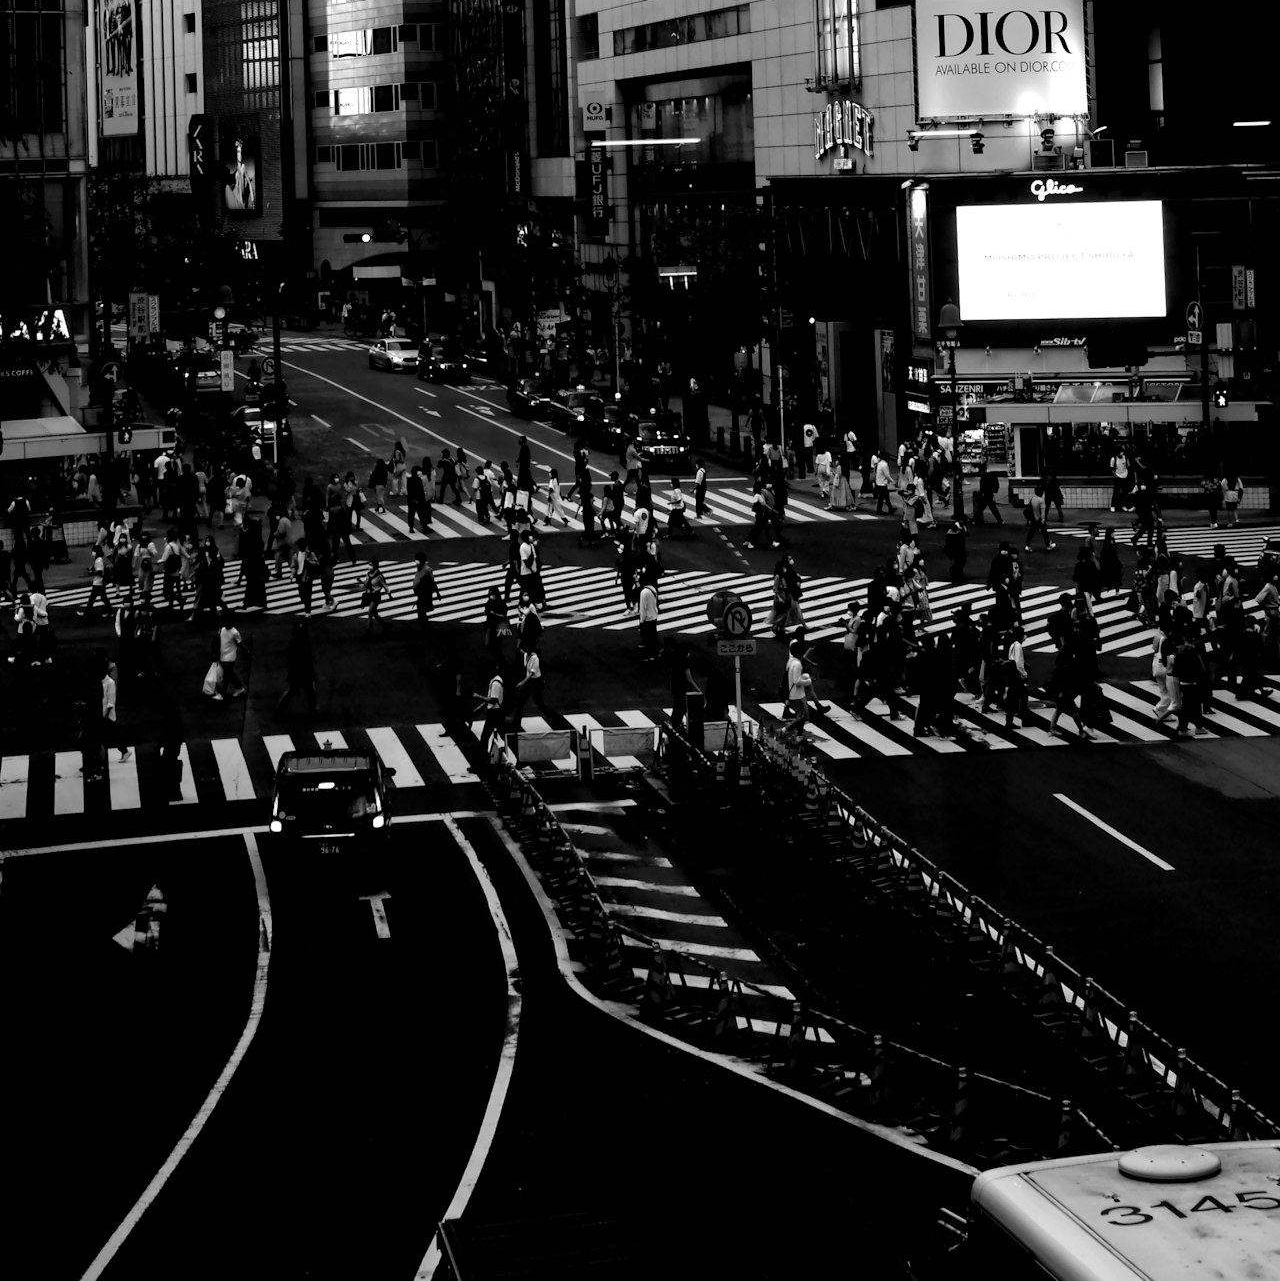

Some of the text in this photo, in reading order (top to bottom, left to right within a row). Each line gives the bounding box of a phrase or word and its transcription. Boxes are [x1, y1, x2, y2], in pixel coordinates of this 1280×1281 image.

[933, 9, 1073, 58] DIOR
[935, 59, 1075, 76] AVAILABLE ON DIOR.CO
[814, 99, 874, 160] MAGNET
[1030, 179, 1084, 202] Glico
[720, 644, 754, 653] ここから
